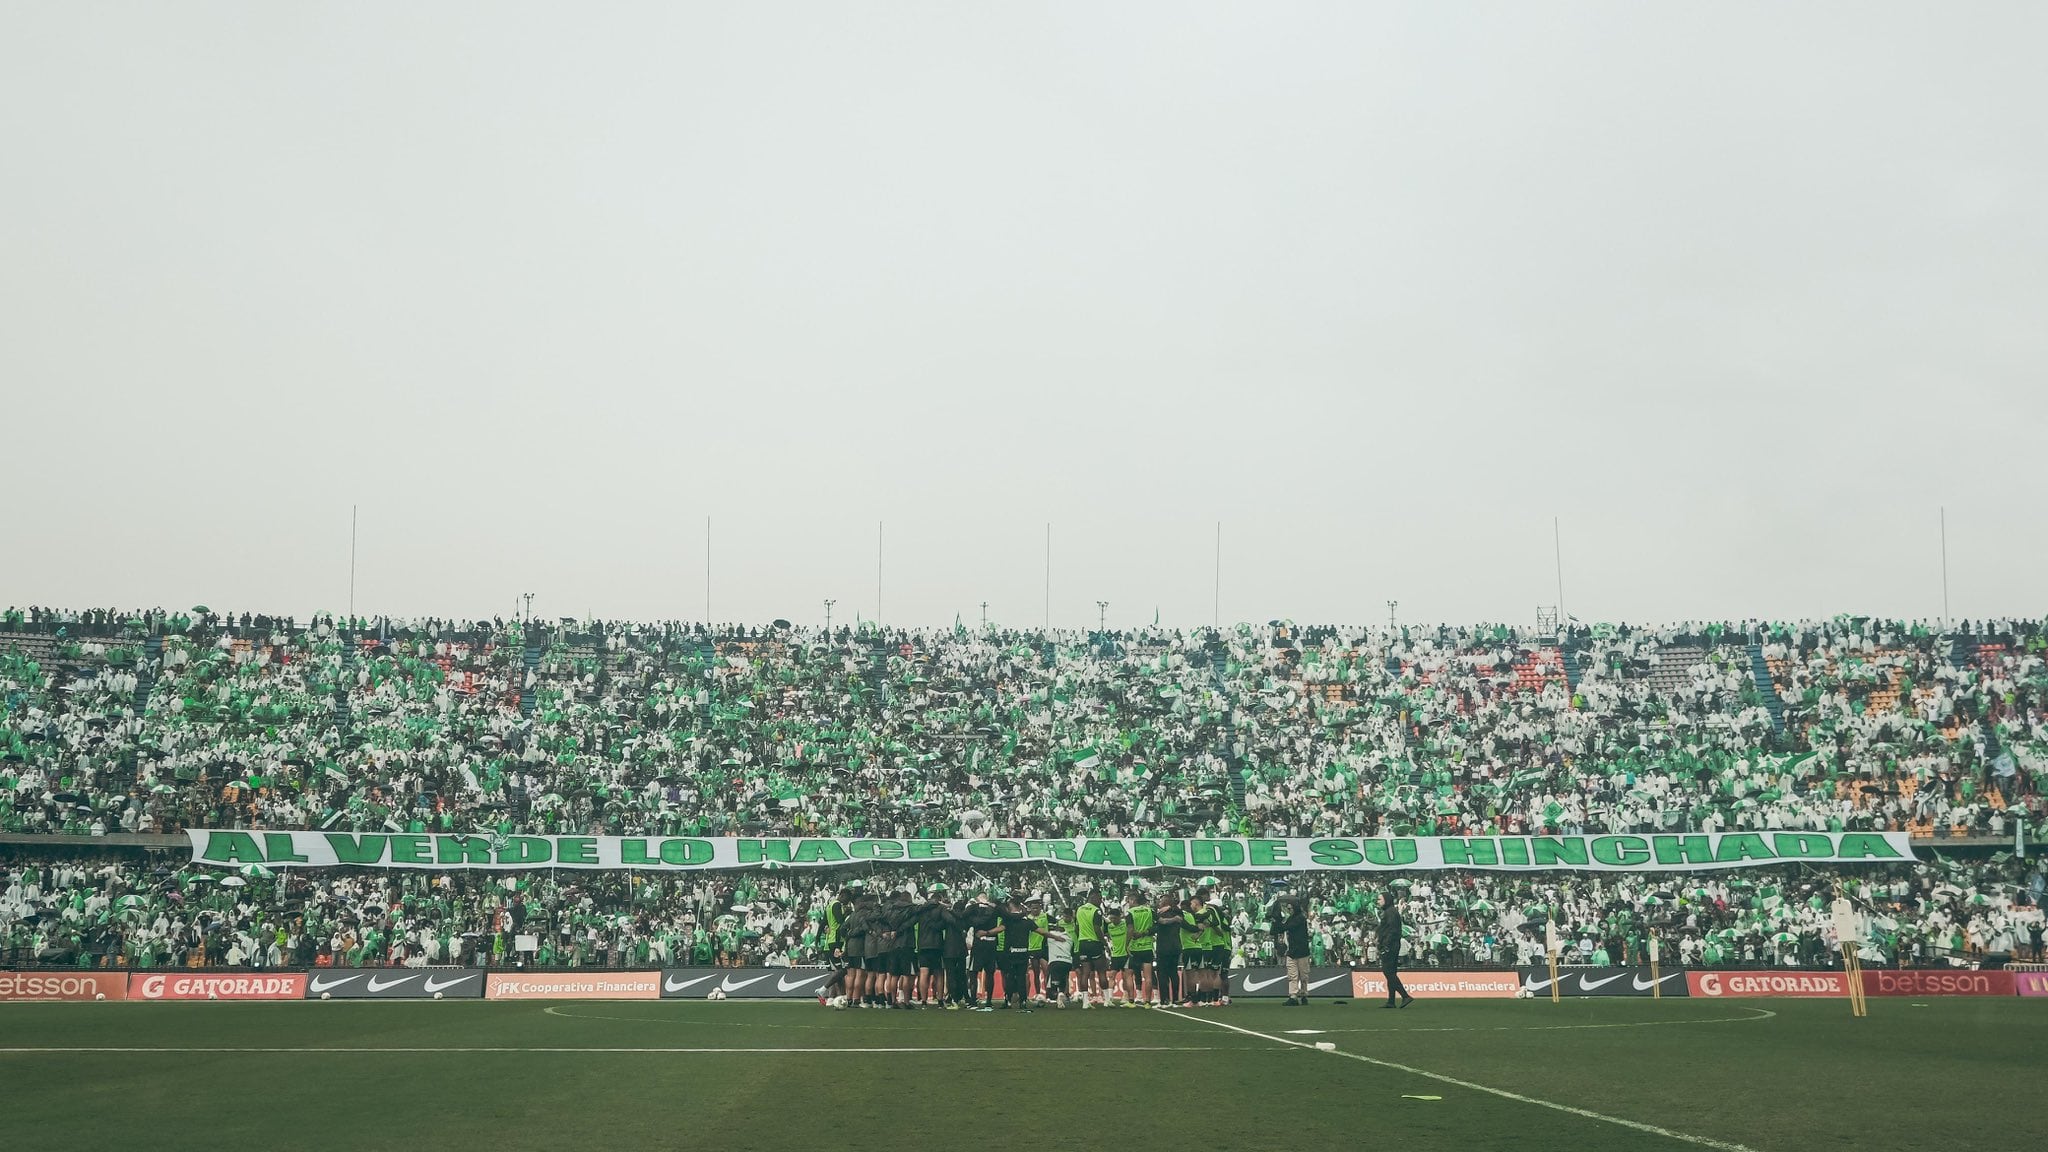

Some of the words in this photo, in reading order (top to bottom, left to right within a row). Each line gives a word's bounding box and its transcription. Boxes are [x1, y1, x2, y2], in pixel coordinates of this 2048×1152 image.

[203, 832, 308, 863] AL
[325, 833, 599, 865] VERDE
[621, 838, 714, 866] LO
[738, 838, 949, 865] HACE
[969, 838, 1292, 867] GRANDE
[1309, 839, 1418, 866] SU
[1441, 832, 1904, 866] HINCHADA
[0, 973, 97, 995] etsson
[173, 978, 295, 995] GATORADE
[521, 981, 594, 994] Cooperativa
[596, 981, 656, 992] Financiera
[1403, 981, 1456, 993] operativa
[1458, 980, 1515, 991] Financiera
[1728, 976, 1841, 993] GATORADE
[1878, 971, 1990, 992] betsson
